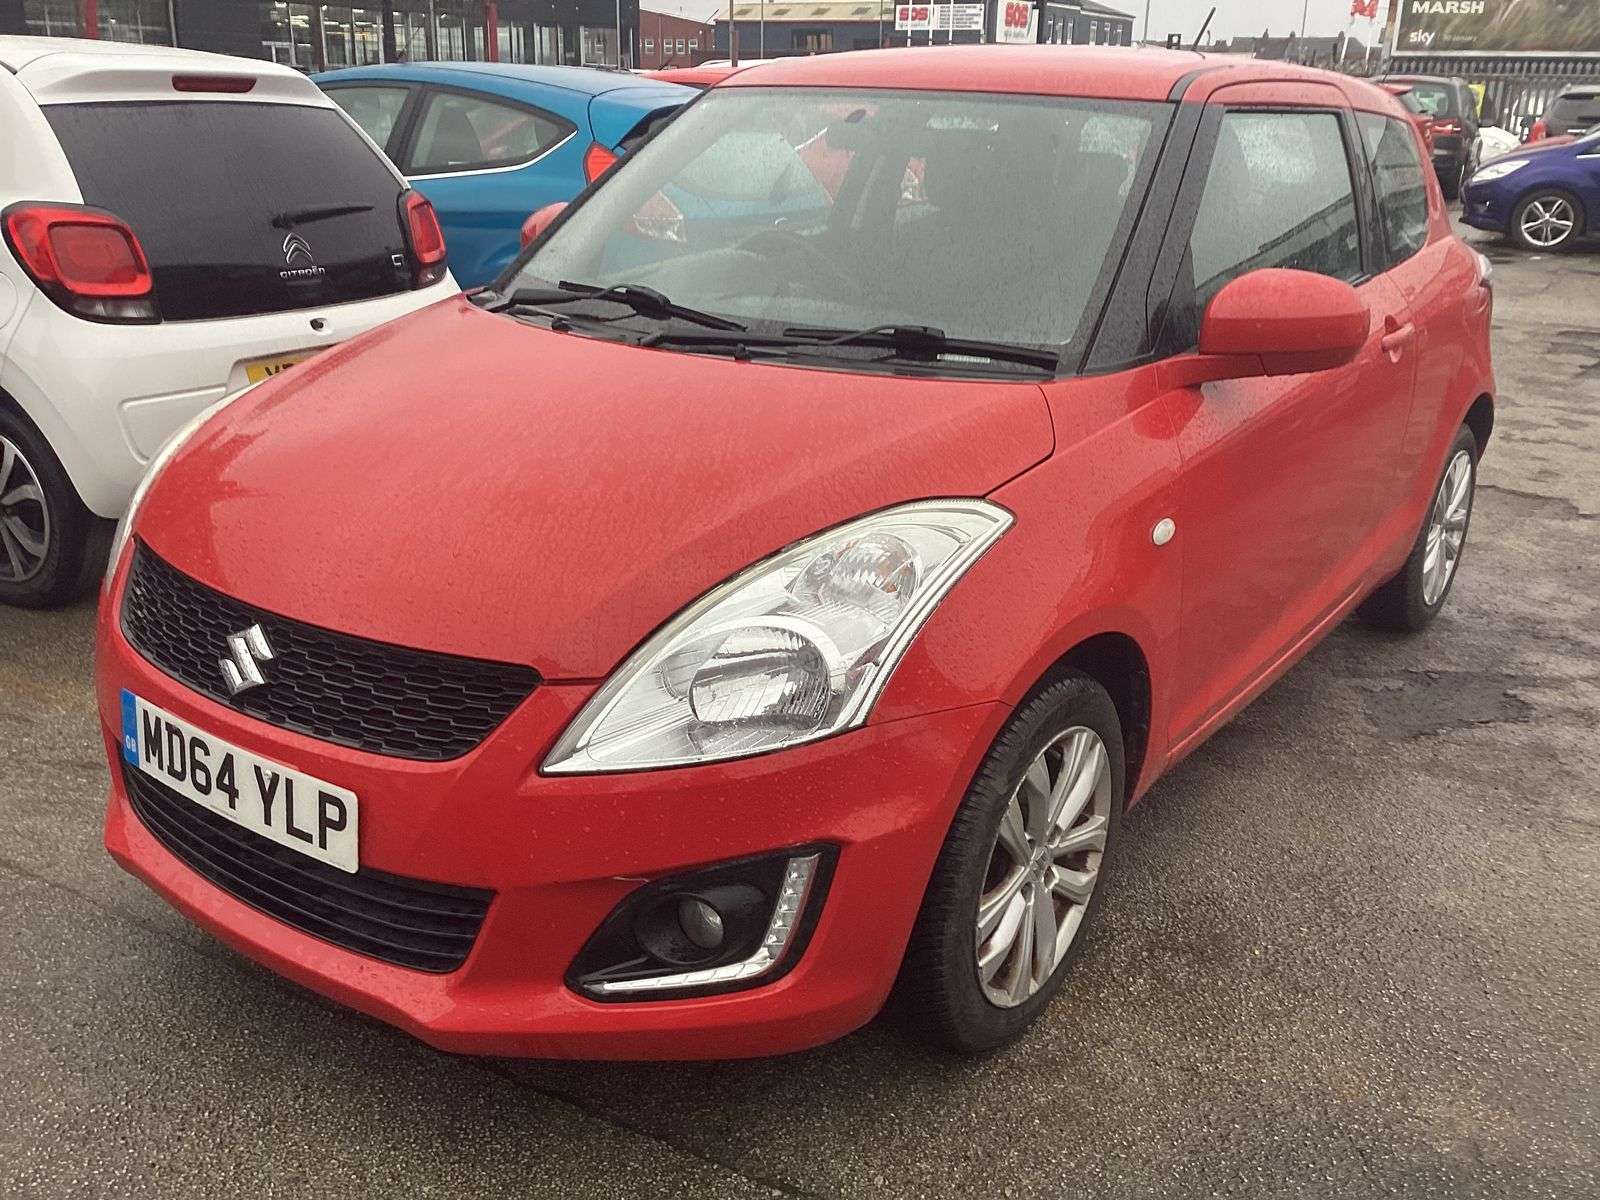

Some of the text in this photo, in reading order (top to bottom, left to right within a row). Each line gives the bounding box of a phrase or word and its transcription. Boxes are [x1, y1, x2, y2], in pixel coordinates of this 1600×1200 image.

[1412, 1, 1485, 14] MARSH
[1409, 29, 1436, 46] sky
[125, 737, 136, 753] GB
[142, 709, 348, 851] MD64 YLP
